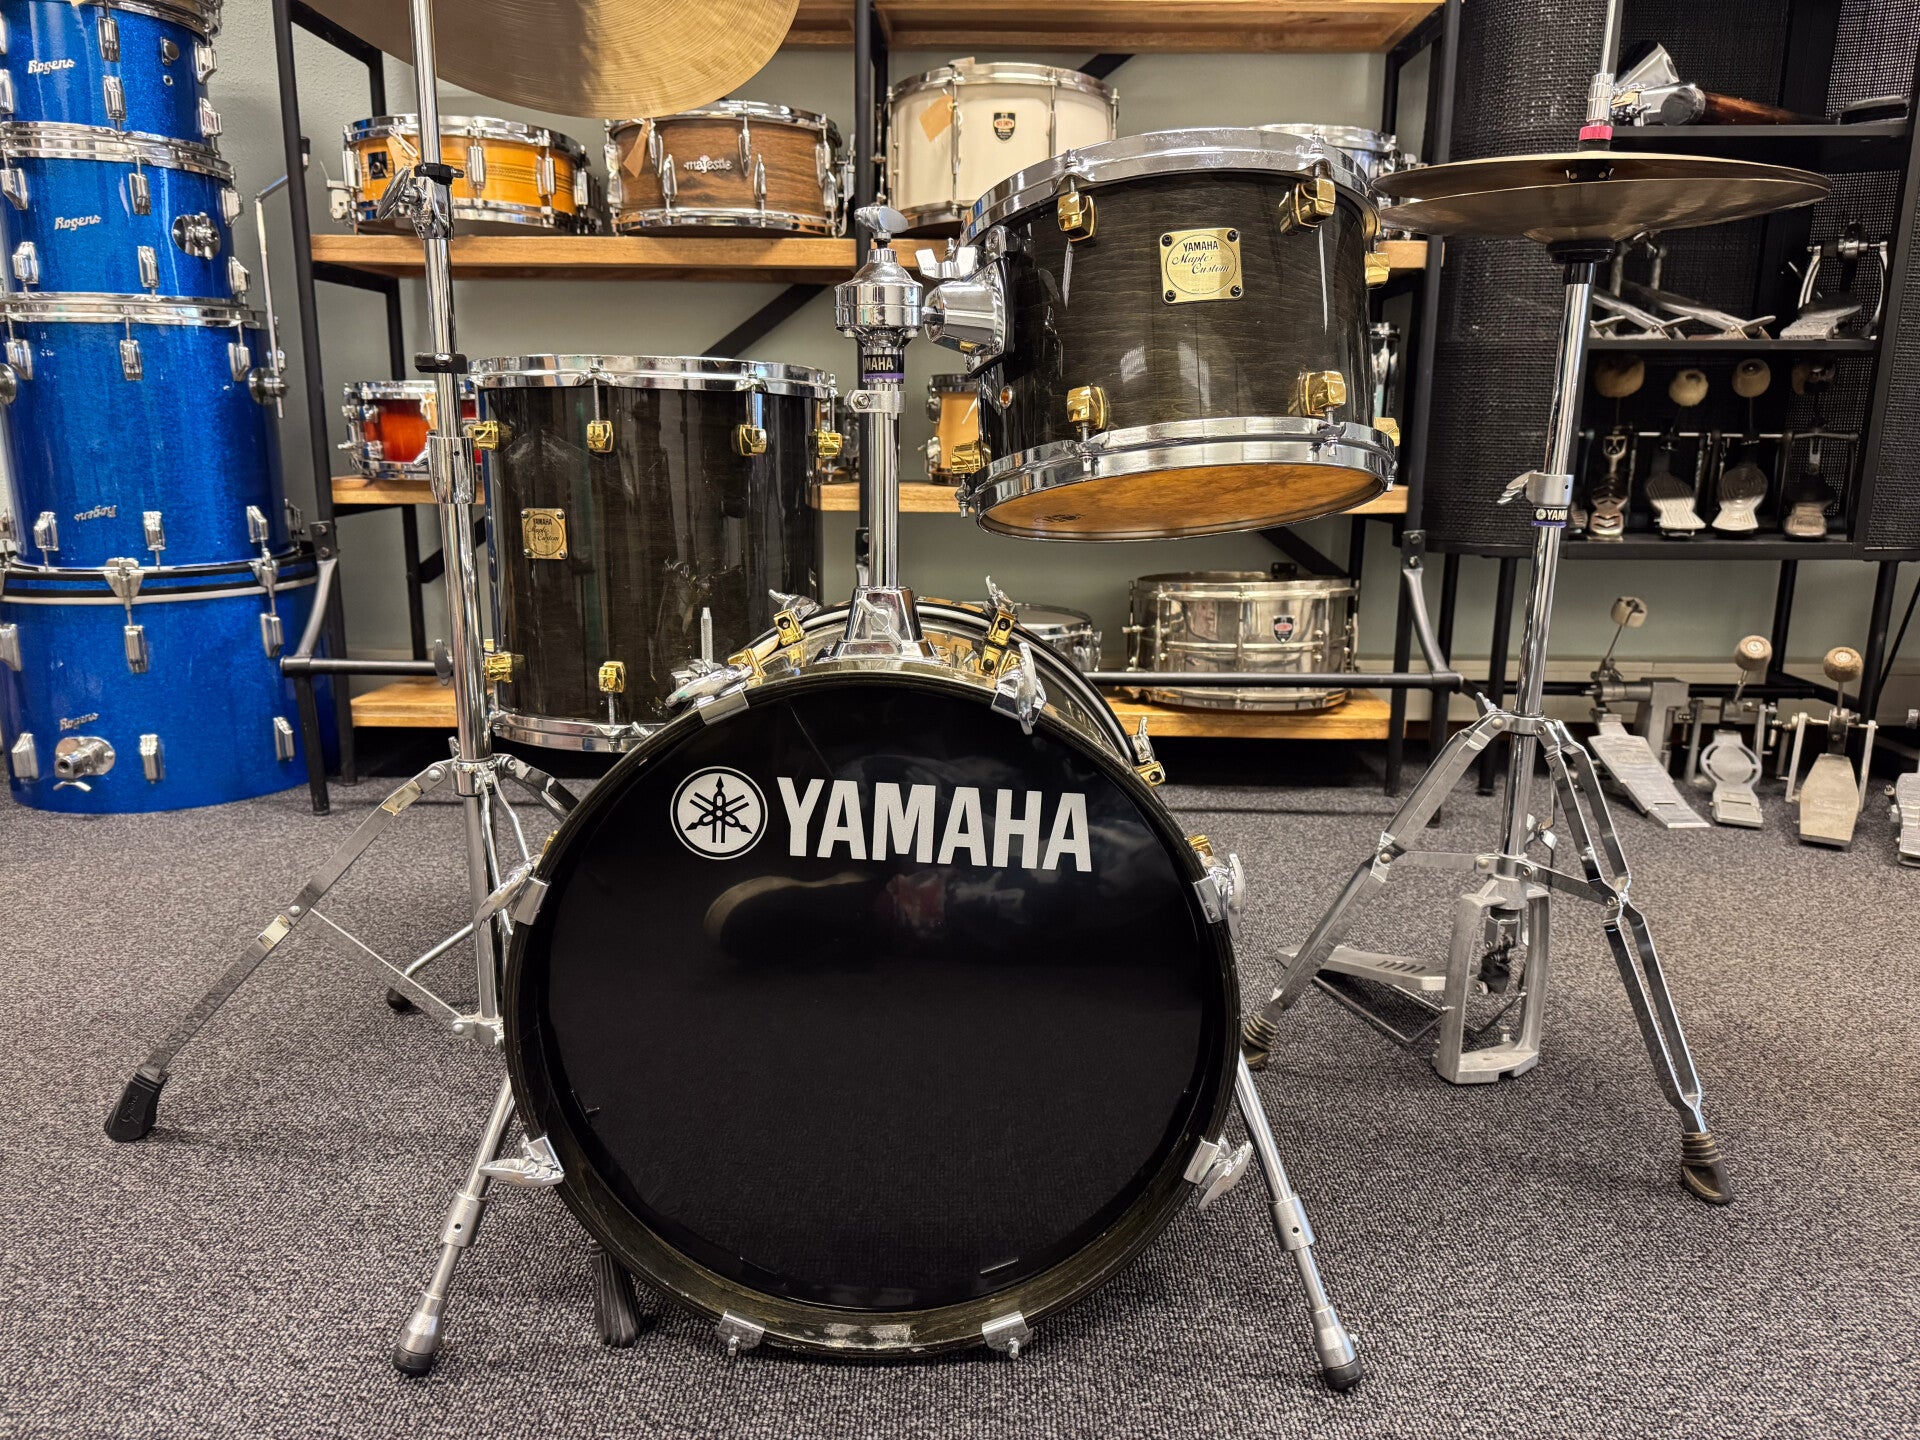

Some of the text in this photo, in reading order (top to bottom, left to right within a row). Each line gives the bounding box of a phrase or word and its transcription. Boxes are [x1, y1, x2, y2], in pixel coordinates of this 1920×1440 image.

[27, 58, 76, 75] Rogers
[54, 214, 102, 231] Rogers
[1182, 240, 1219, 252] YAMAHA
[1171, 252, 1213, 266] Maple
[1191, 262, 1230, 275] Custom
[776, 776, 1092, 872] YAMAHA
